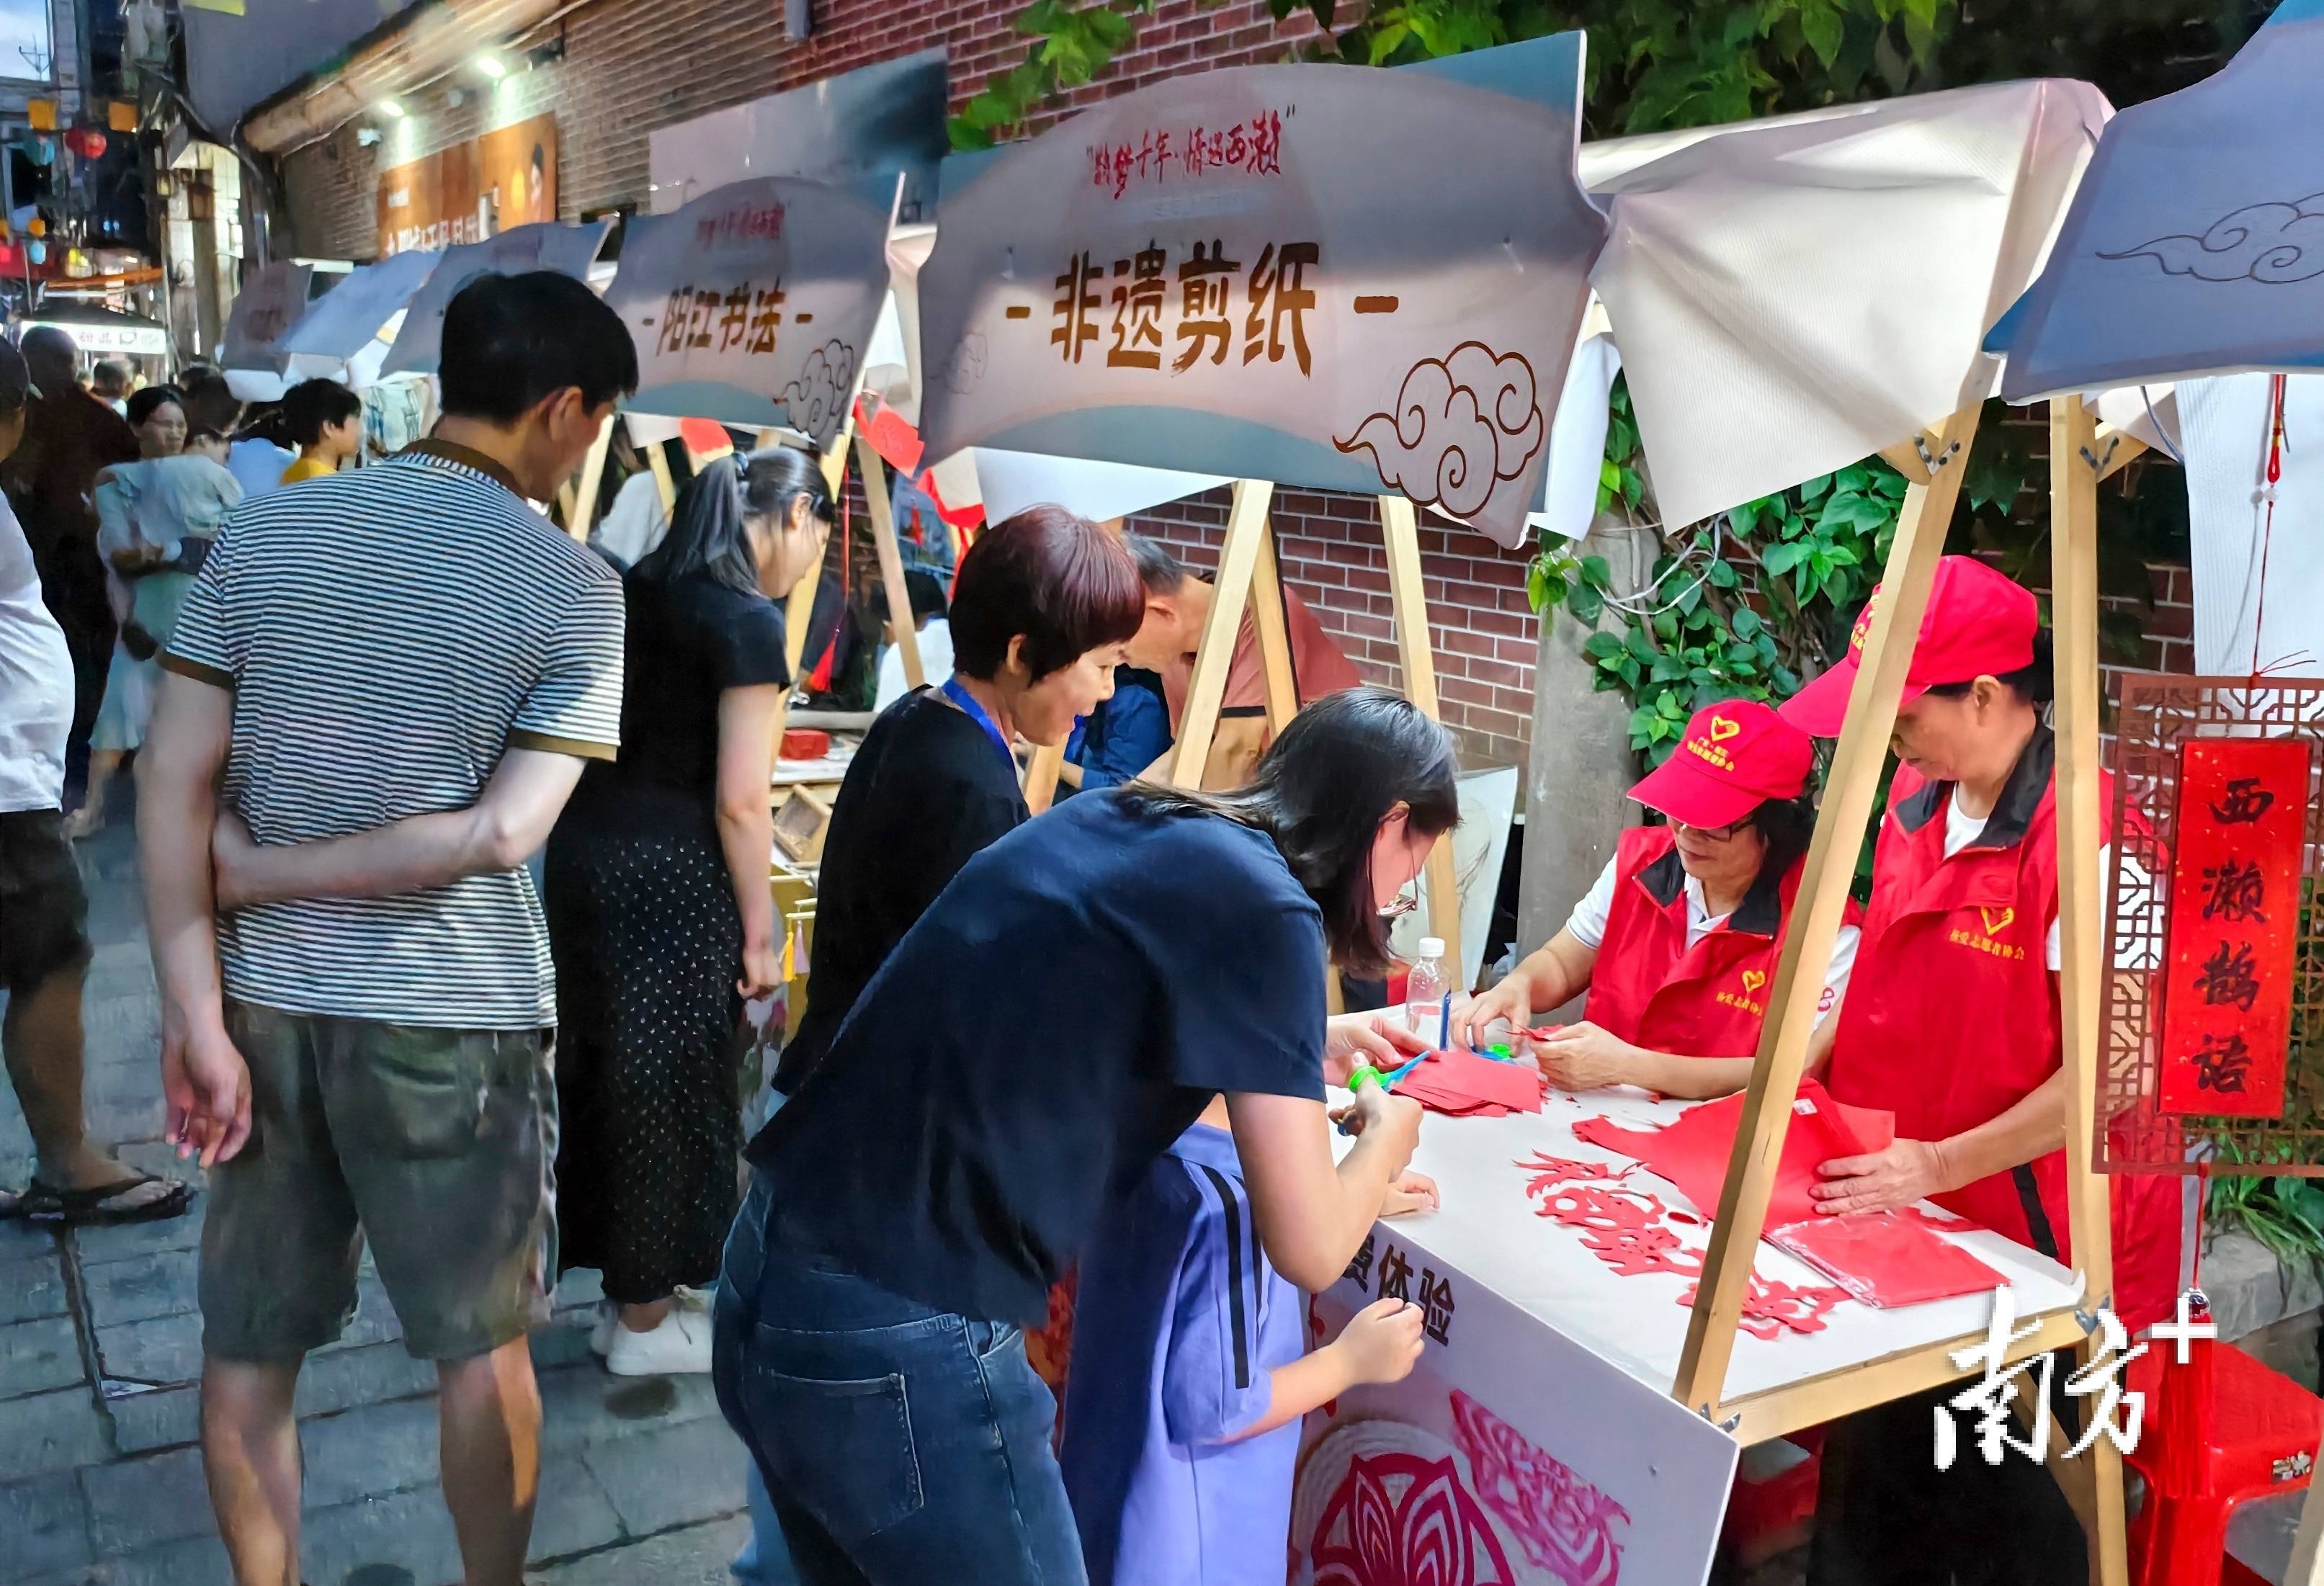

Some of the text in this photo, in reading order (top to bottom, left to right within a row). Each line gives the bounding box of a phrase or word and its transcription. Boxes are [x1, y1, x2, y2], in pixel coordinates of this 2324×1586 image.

[656, 276, 786, 357] 阳江书法
[1050, 237, 1320, 380] 非遗剪纸
[2191, 776, 2275, 1094] 西濑鹊语
